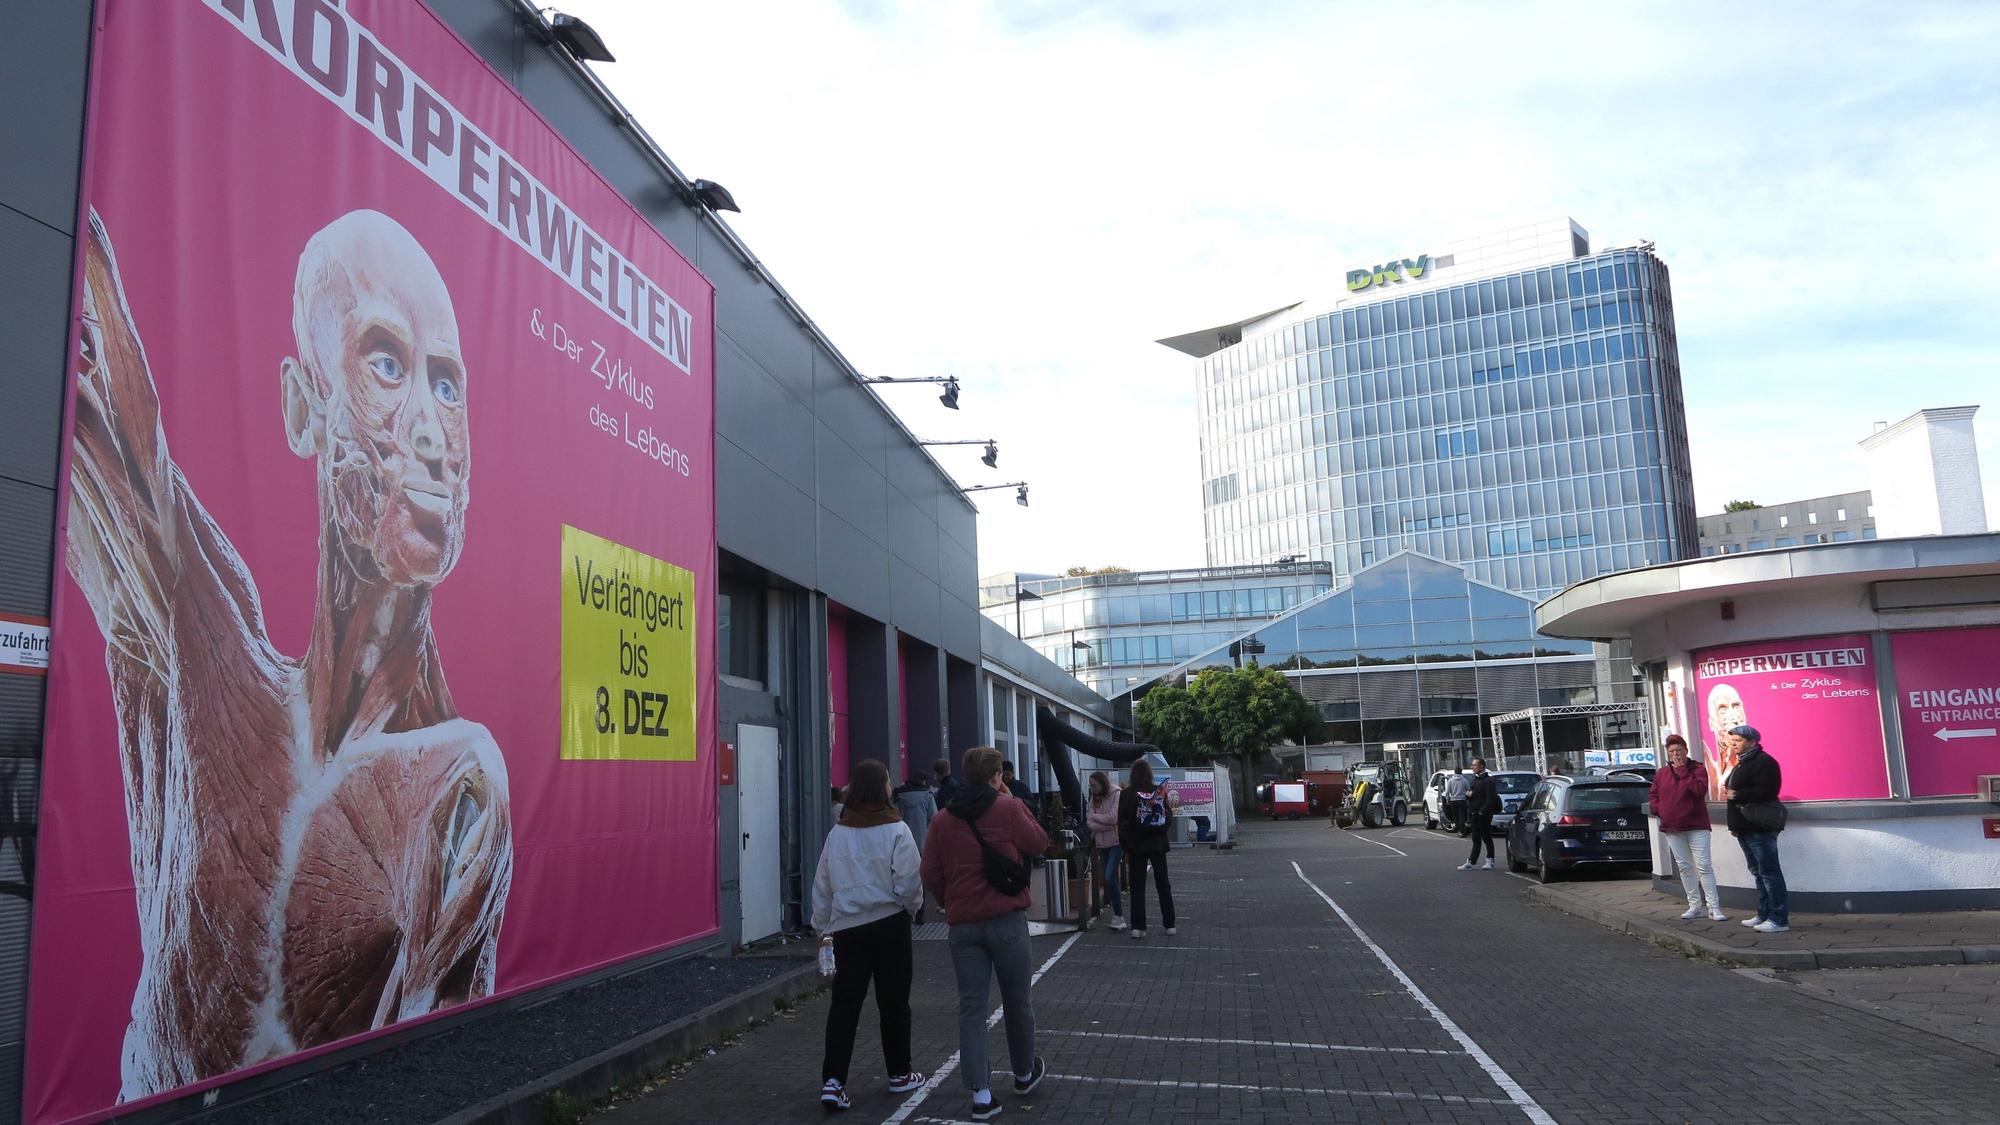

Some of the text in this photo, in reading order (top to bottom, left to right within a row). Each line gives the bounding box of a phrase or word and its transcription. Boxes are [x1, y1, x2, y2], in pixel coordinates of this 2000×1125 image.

[218, 0, 690, 370] ÖRPERWELTEN
[1346, 253, 1428, 292] DKV
[530, 307, 654, 410] & Der Zyklus
[589, 403, 690, 477] des Lebens
[575, 554, 684, 633] Verlängert
[0, 631, 50, 652] zufahrt
[619, 628, 649, 679] bis
[1699, 648, 1865, 679] KÖRPERWELTEN
[1769, 677, 1842, 690] & Der Zyklus
[1801, 687, 1870, 700] des Lebens
[595, 685, 670, 737] 8. DEZ
[1628, 752, 1655, 762] YGO
